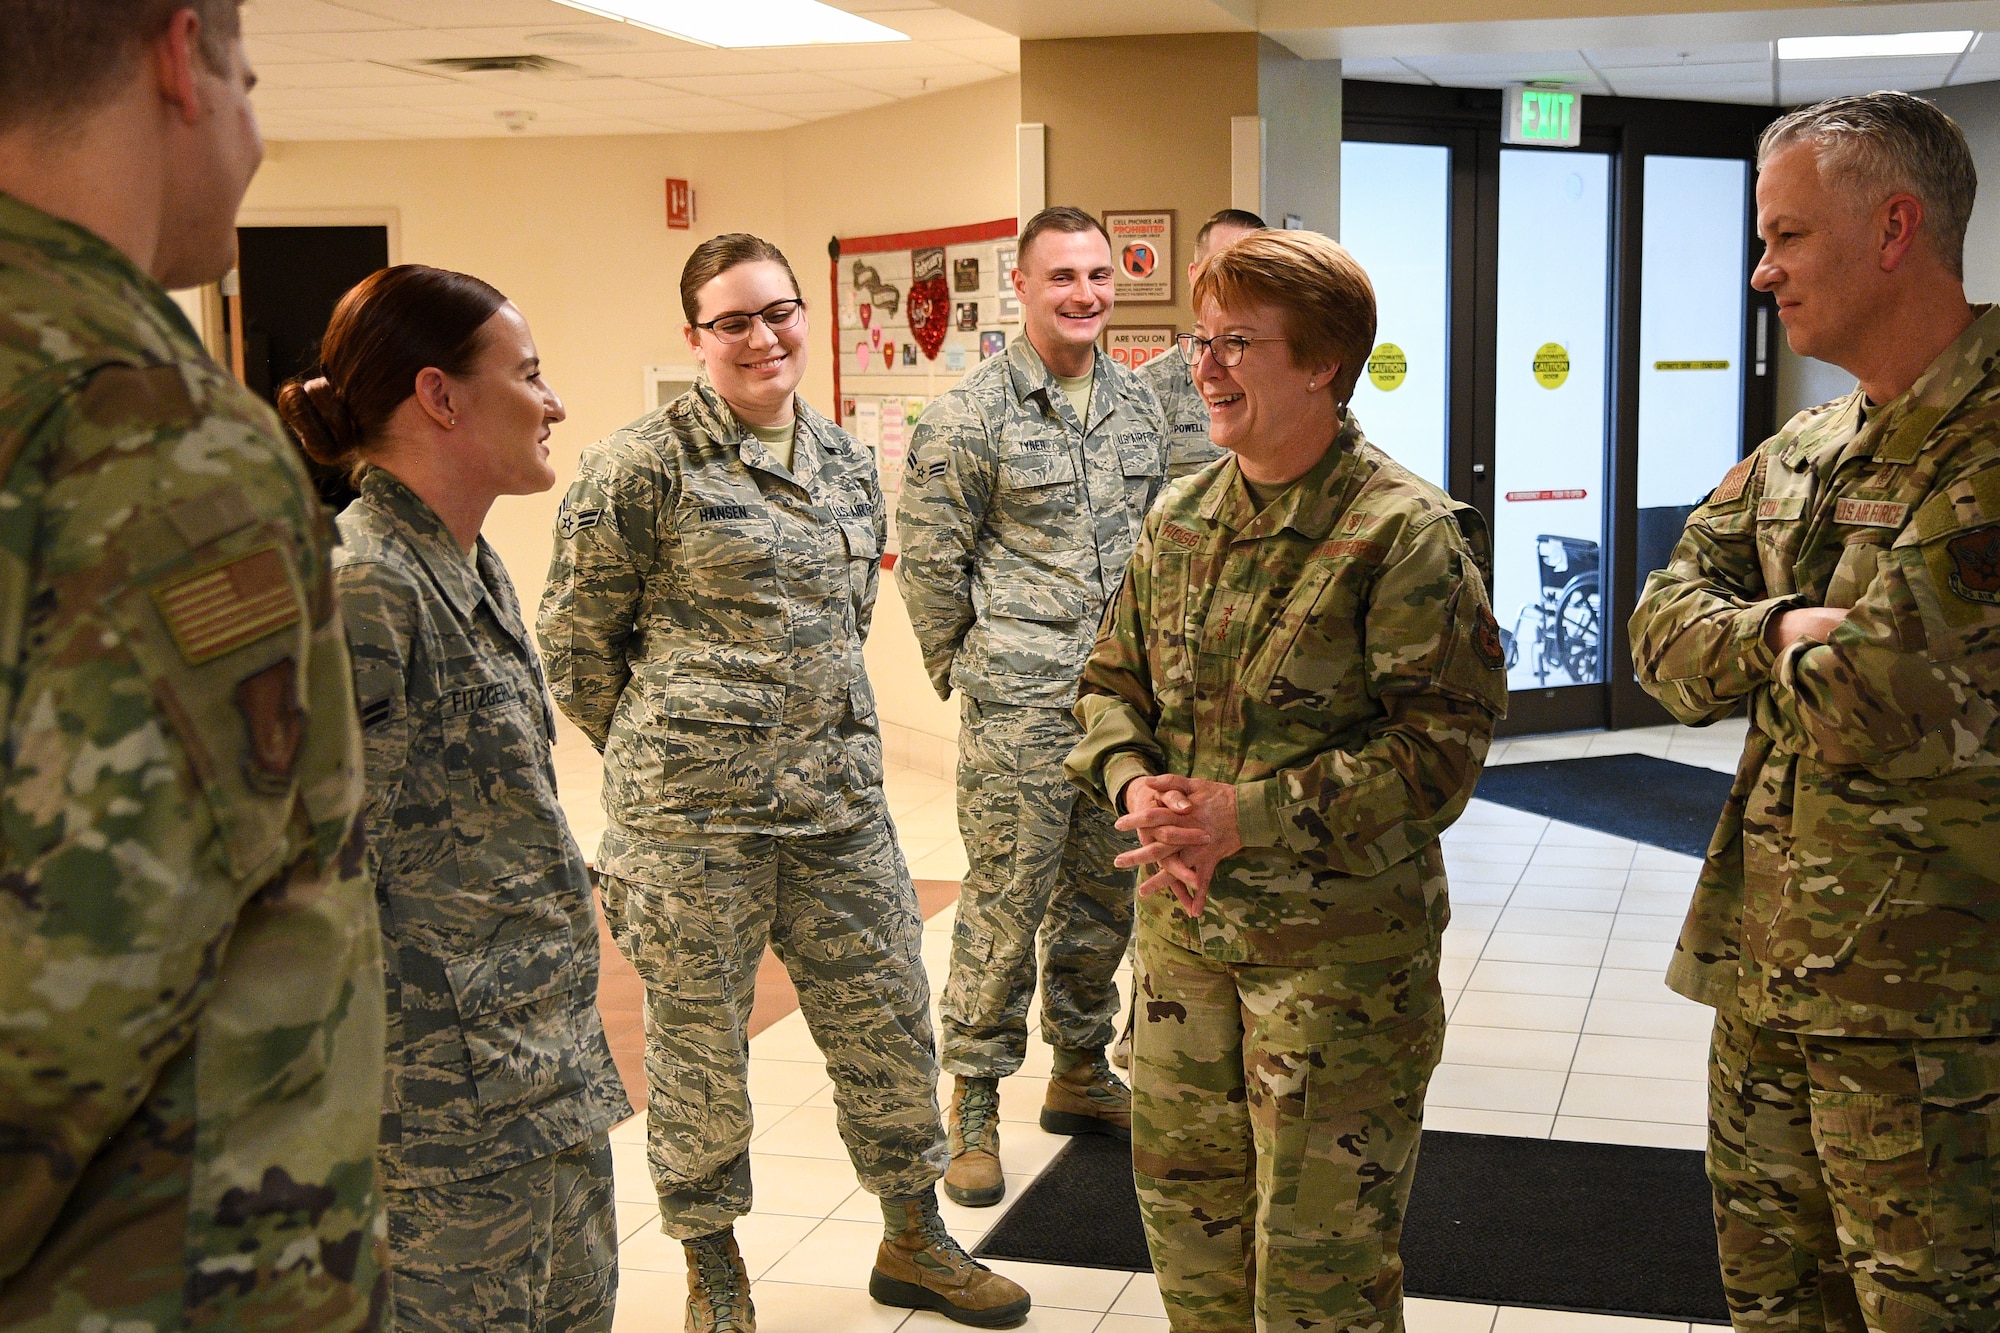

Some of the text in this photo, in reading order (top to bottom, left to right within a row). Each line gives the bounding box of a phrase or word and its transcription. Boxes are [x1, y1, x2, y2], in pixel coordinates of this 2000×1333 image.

[1522, 91, 1575, 140] EXIT
[1113, 225, 1165, 234] PROHIBITED
[1114, 335, 1129, 343] ARE
[1369, 363, 1405, 373] CAUTION
[1534, 362, 1568, 372] CAUTION
[1174, 423, 1205, 433] POWELL
[1130, 432, 1143, 443] AIR
[700, 505, 748, 522] HANSEN
[850, 504, 866, 517] AIR
[1837, 500, 1904, 524] U.S. AIR FORCE
[1162, 523, 1200, 547] HOGG
